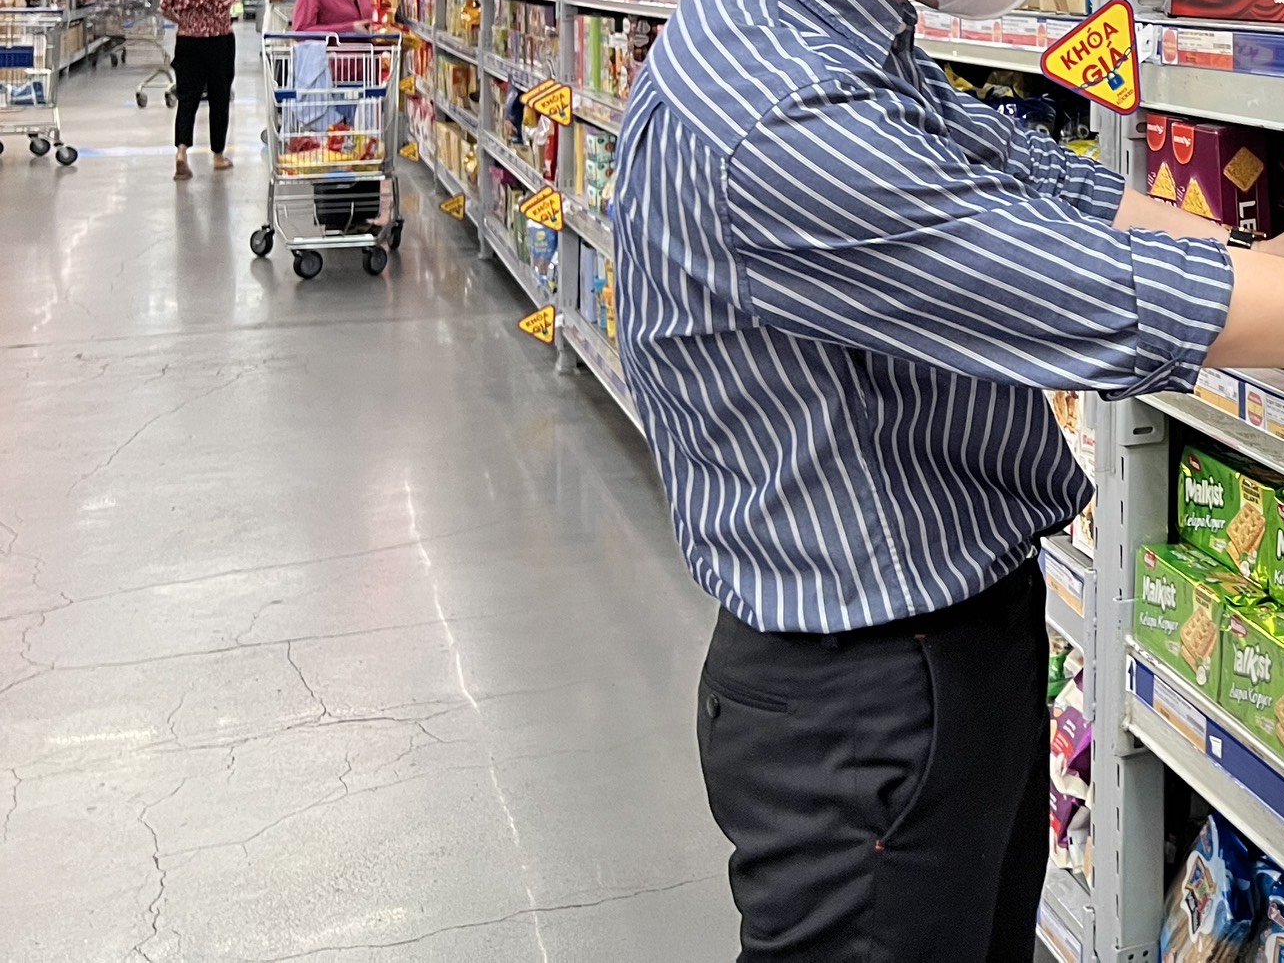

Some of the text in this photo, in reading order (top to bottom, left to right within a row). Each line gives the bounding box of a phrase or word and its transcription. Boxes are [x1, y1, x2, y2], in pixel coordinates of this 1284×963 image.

[1059, 22, 1119, 71] KHÓA
[1082, 41, 1128, 86] GIÁ
[1184, 477, 1225, 508] Malkist
[1142, 575, 1177, 609] Malkist
